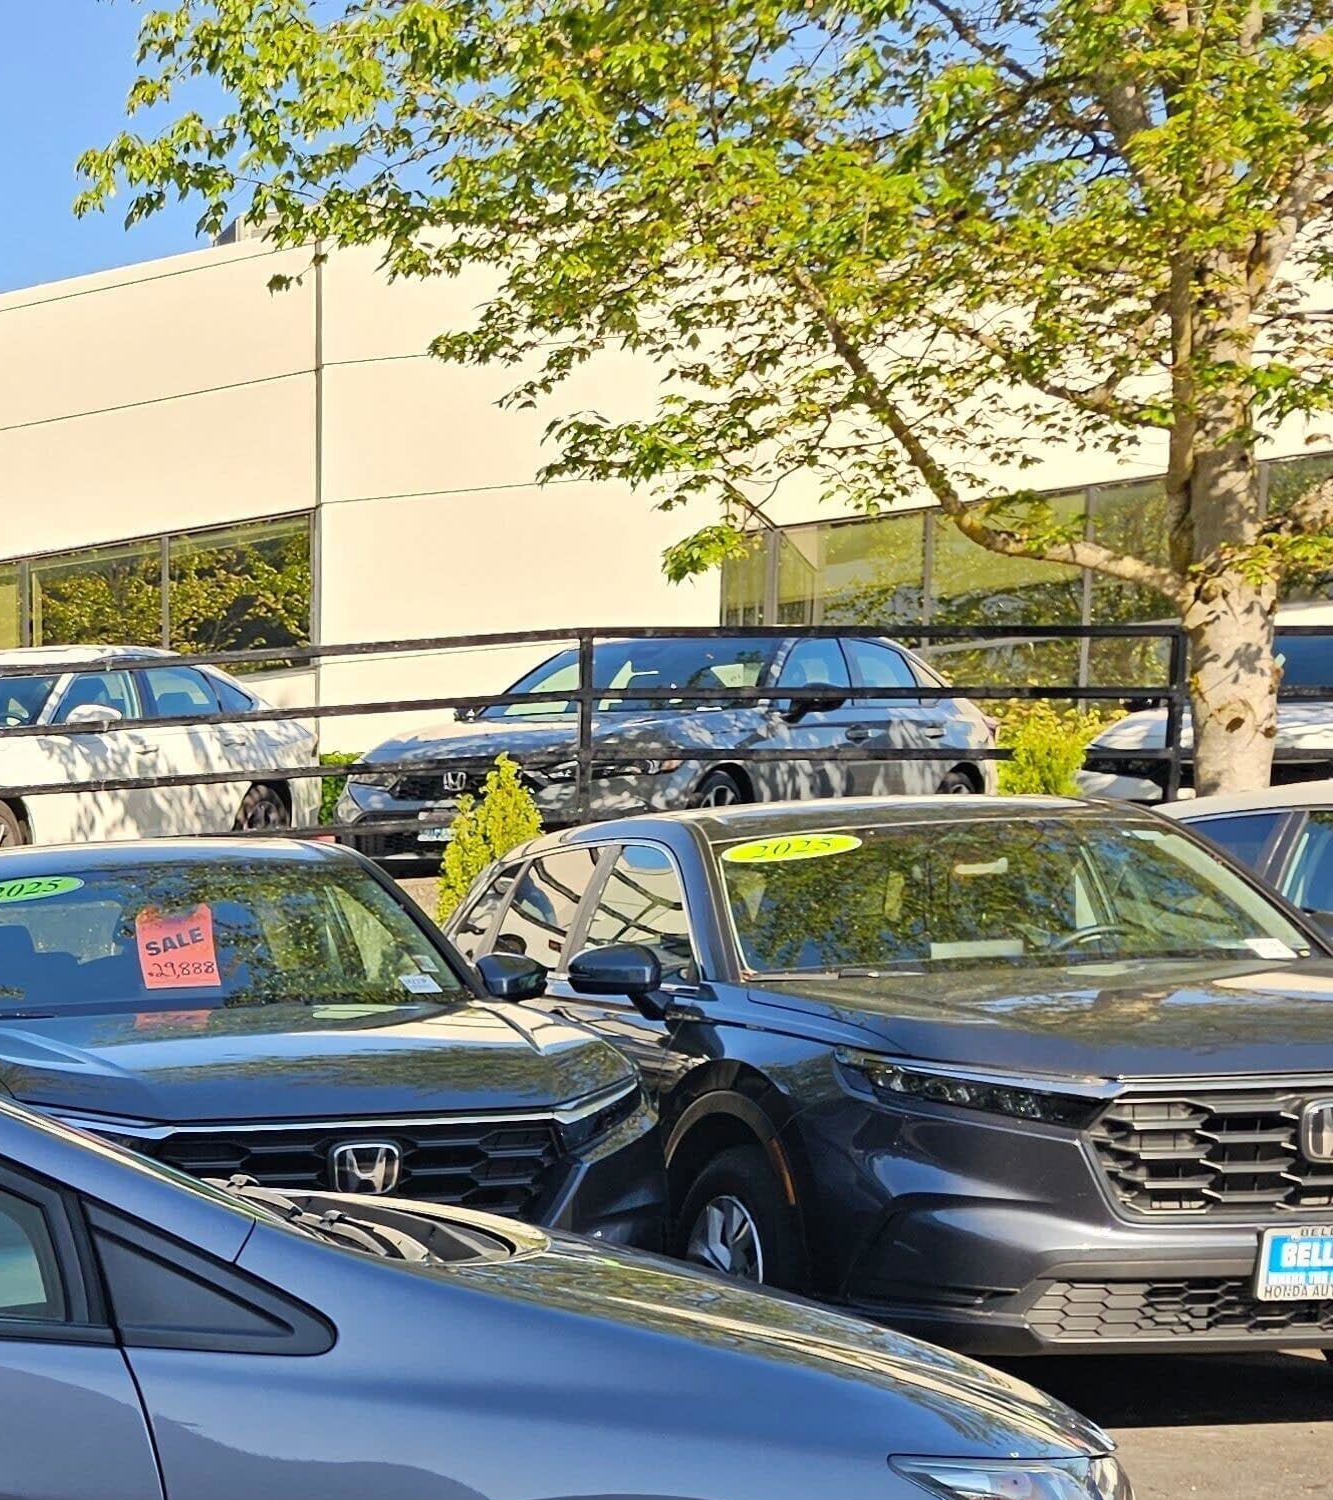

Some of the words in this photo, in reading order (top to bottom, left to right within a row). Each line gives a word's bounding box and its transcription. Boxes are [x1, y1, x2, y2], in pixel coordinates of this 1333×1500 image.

[750, 837, 833, 859] 2025
[145, 927, 205, 956] SALE
[1264, 1285, 1308, 1298] HONDA
[1312, 1284, 1333, 1297] AU
